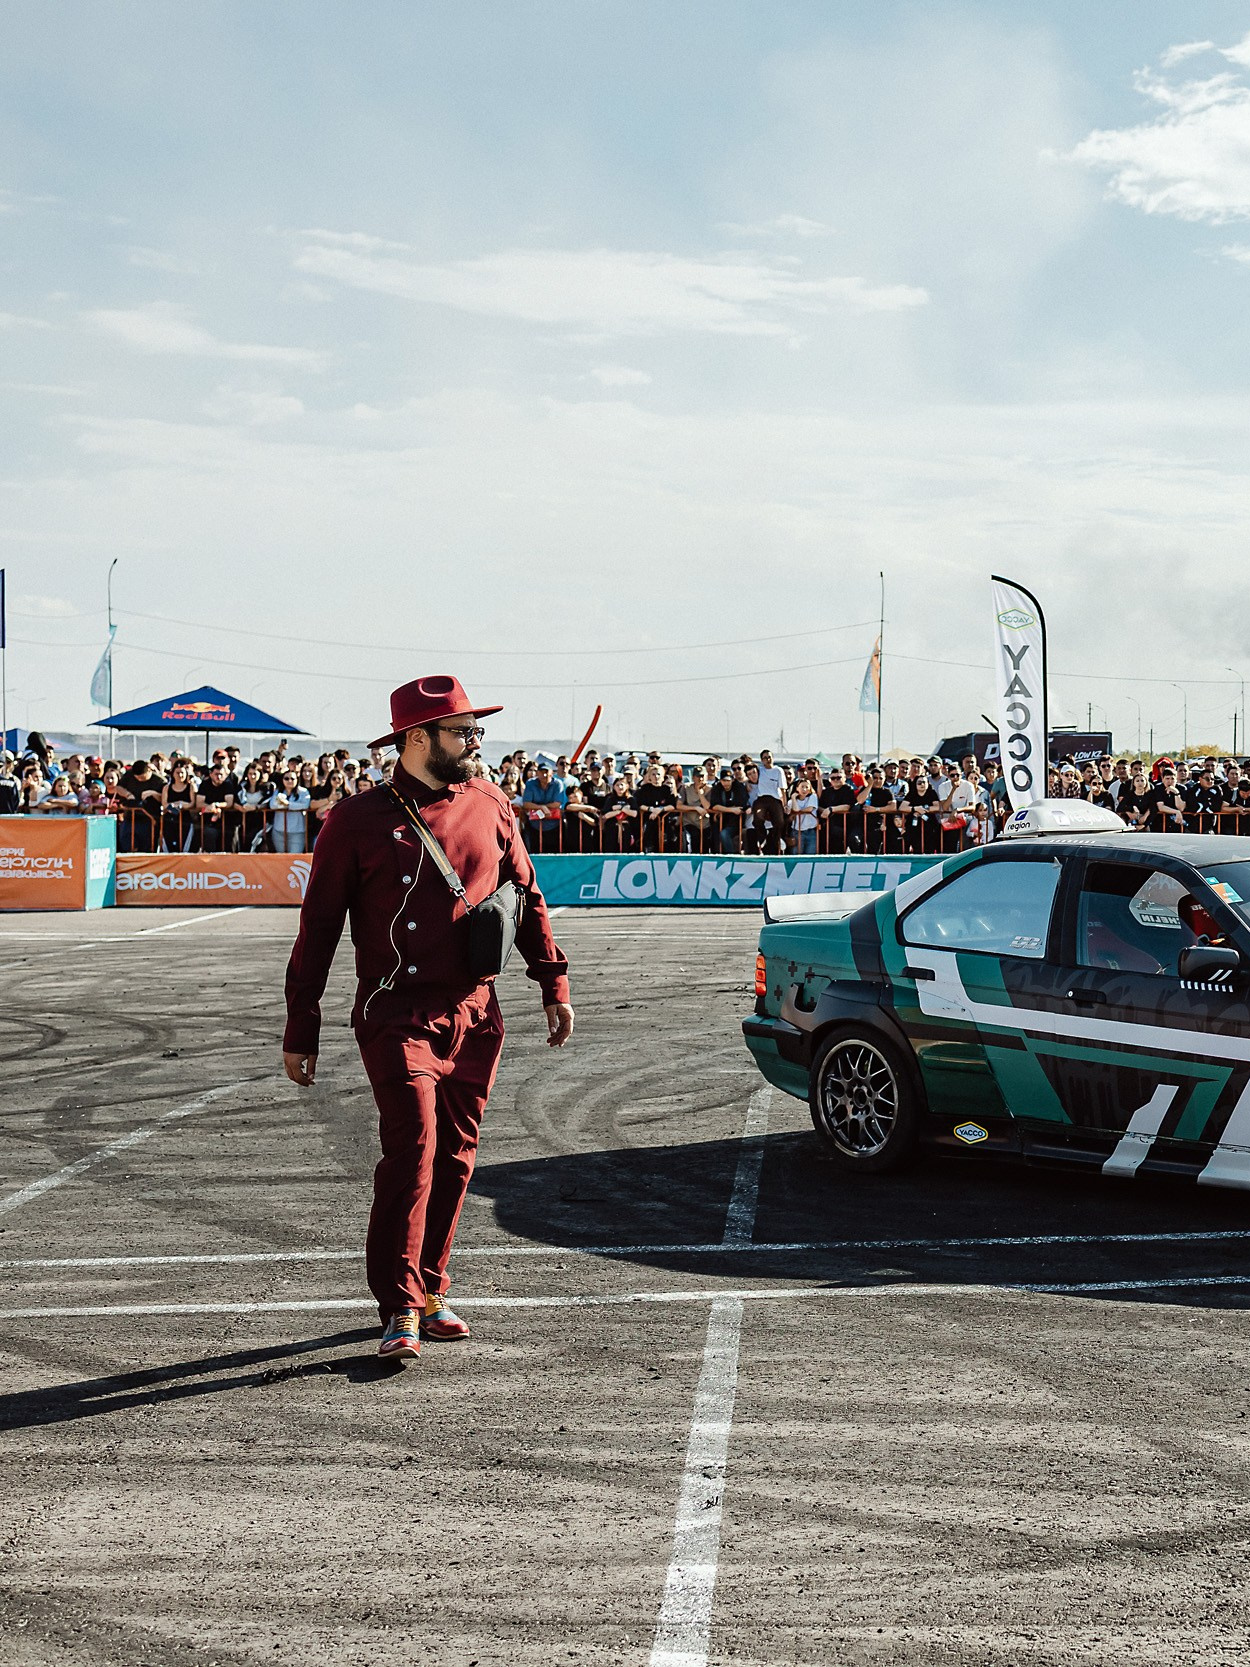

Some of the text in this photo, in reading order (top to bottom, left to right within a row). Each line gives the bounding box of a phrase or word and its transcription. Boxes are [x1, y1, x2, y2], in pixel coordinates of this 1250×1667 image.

[162, 711, 235, 721] Red Bull
[1008, 821, 1030, 831] region
[959, 1129, 983, 1137] YACCO
